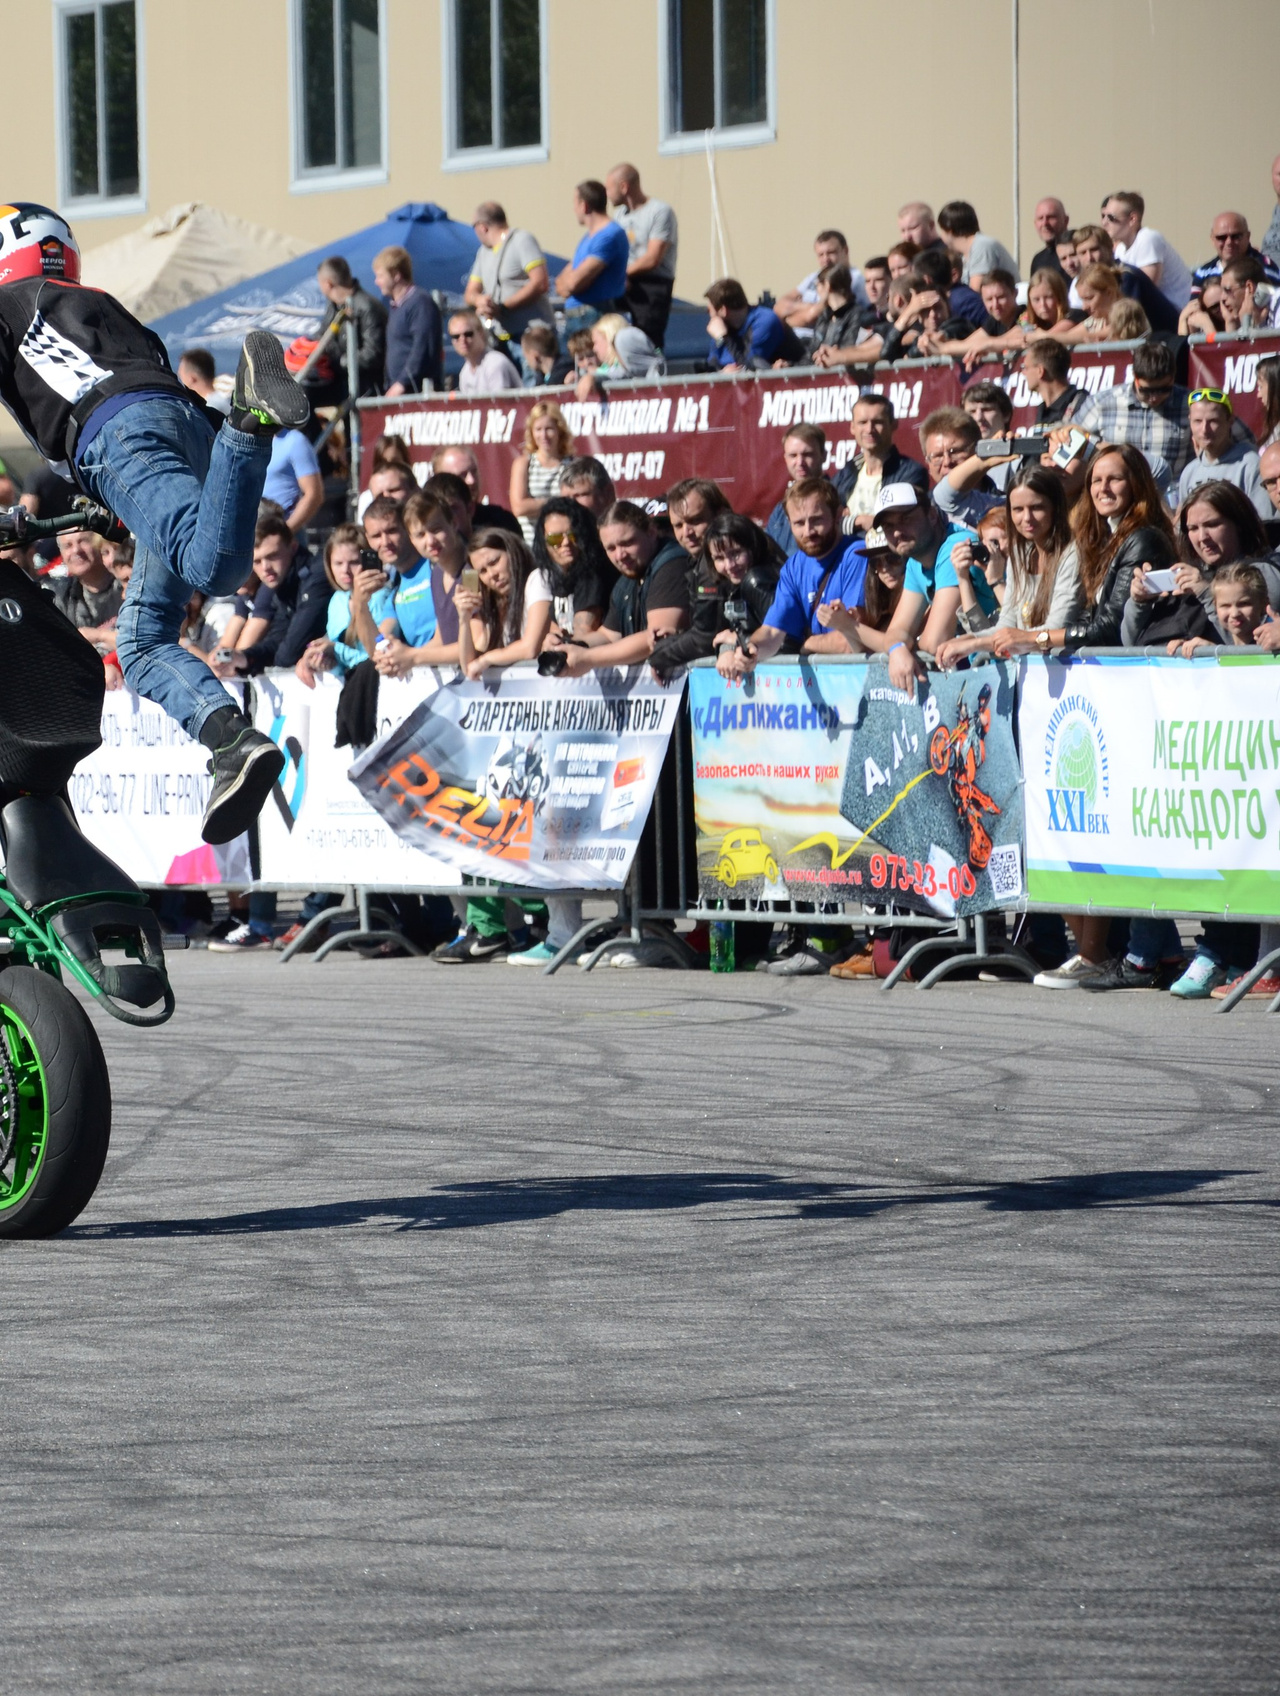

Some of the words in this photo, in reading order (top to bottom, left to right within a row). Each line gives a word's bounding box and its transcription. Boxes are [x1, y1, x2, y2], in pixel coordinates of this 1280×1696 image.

[758, 384, 884, 428] МОТОШКО
[459, 700, 552, 731] СТАРТЕРНЫЕ
[773, 765, 811, 779] наших
[815, 765, 840, 783] руках
[1046, 788, 1086, 833] XXI
[1087, 813, 1110, 834] ВЕК
[1132, 787, 1267, 851] КАЖДОГО
